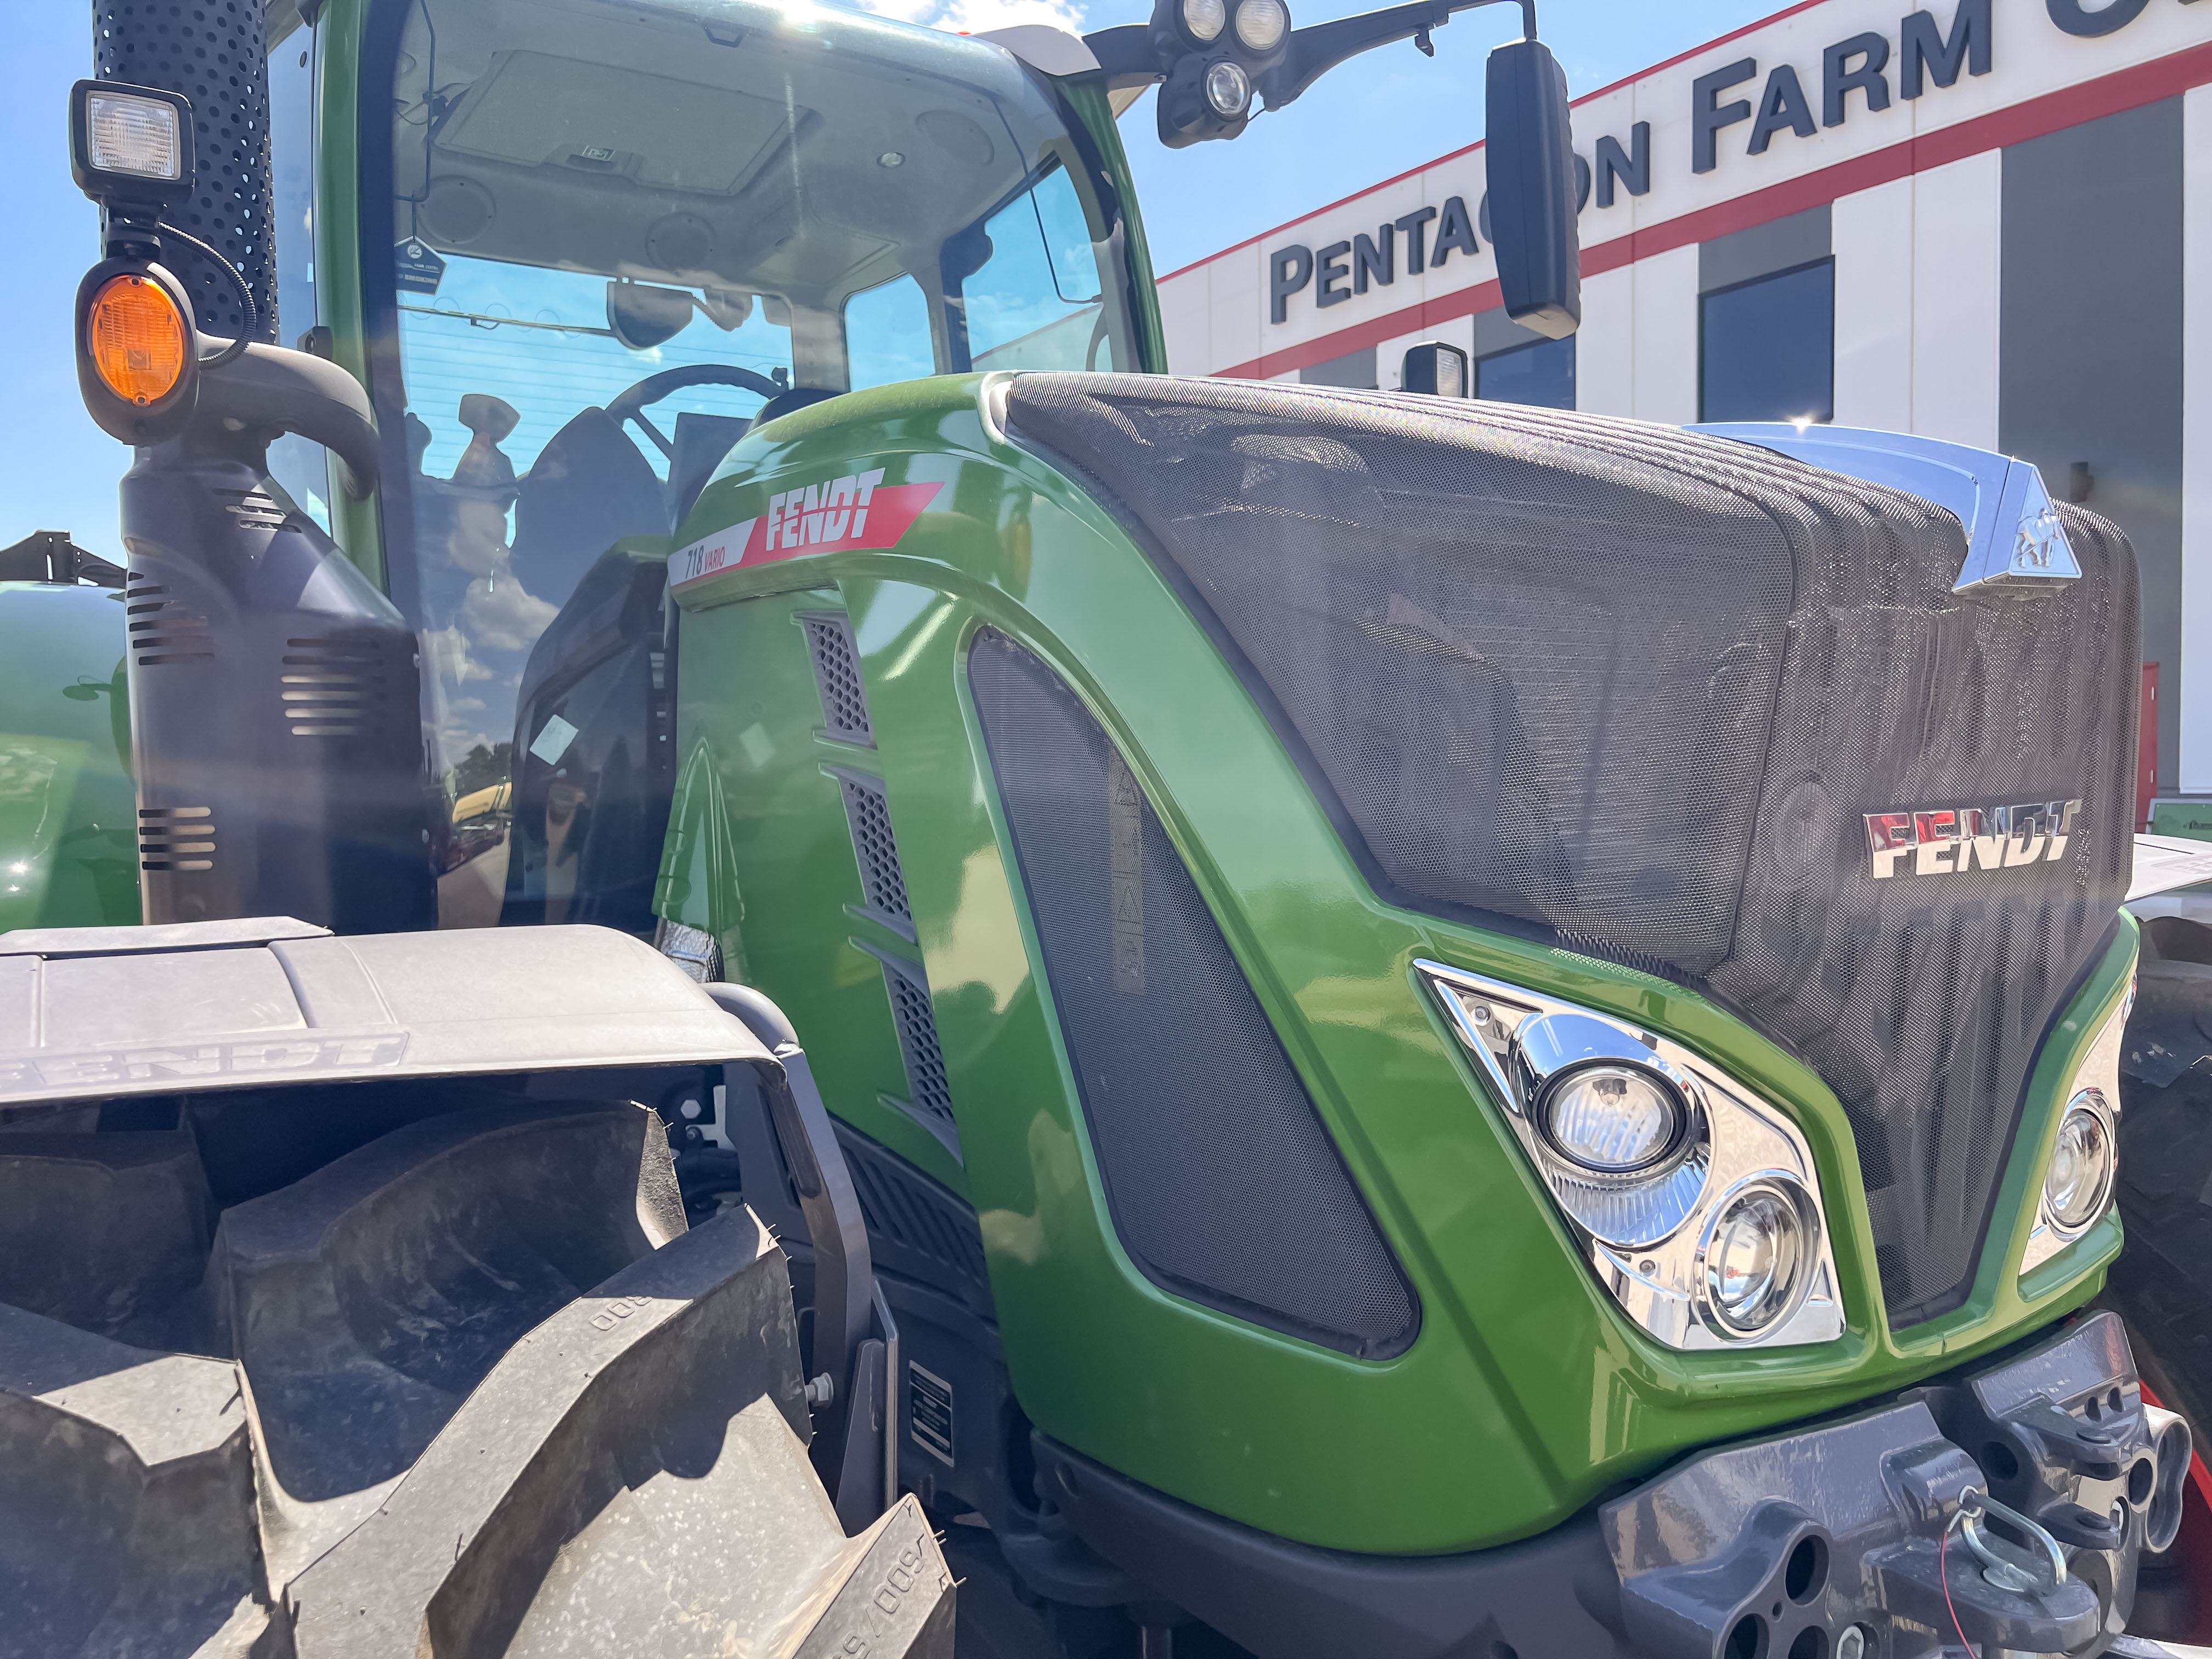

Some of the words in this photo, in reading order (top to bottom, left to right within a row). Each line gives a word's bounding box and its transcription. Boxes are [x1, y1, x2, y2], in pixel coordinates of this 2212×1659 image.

[1271, 121, 1650, 325] PENTAN
[1692, 0, 1991, 173] FARM
[766, 467, 885, 551] FENDT
[685, 545, 704, 580] 718
[704, 546, 725, 573] VARIO
[1863, 799, 2082, 879] FENDT
